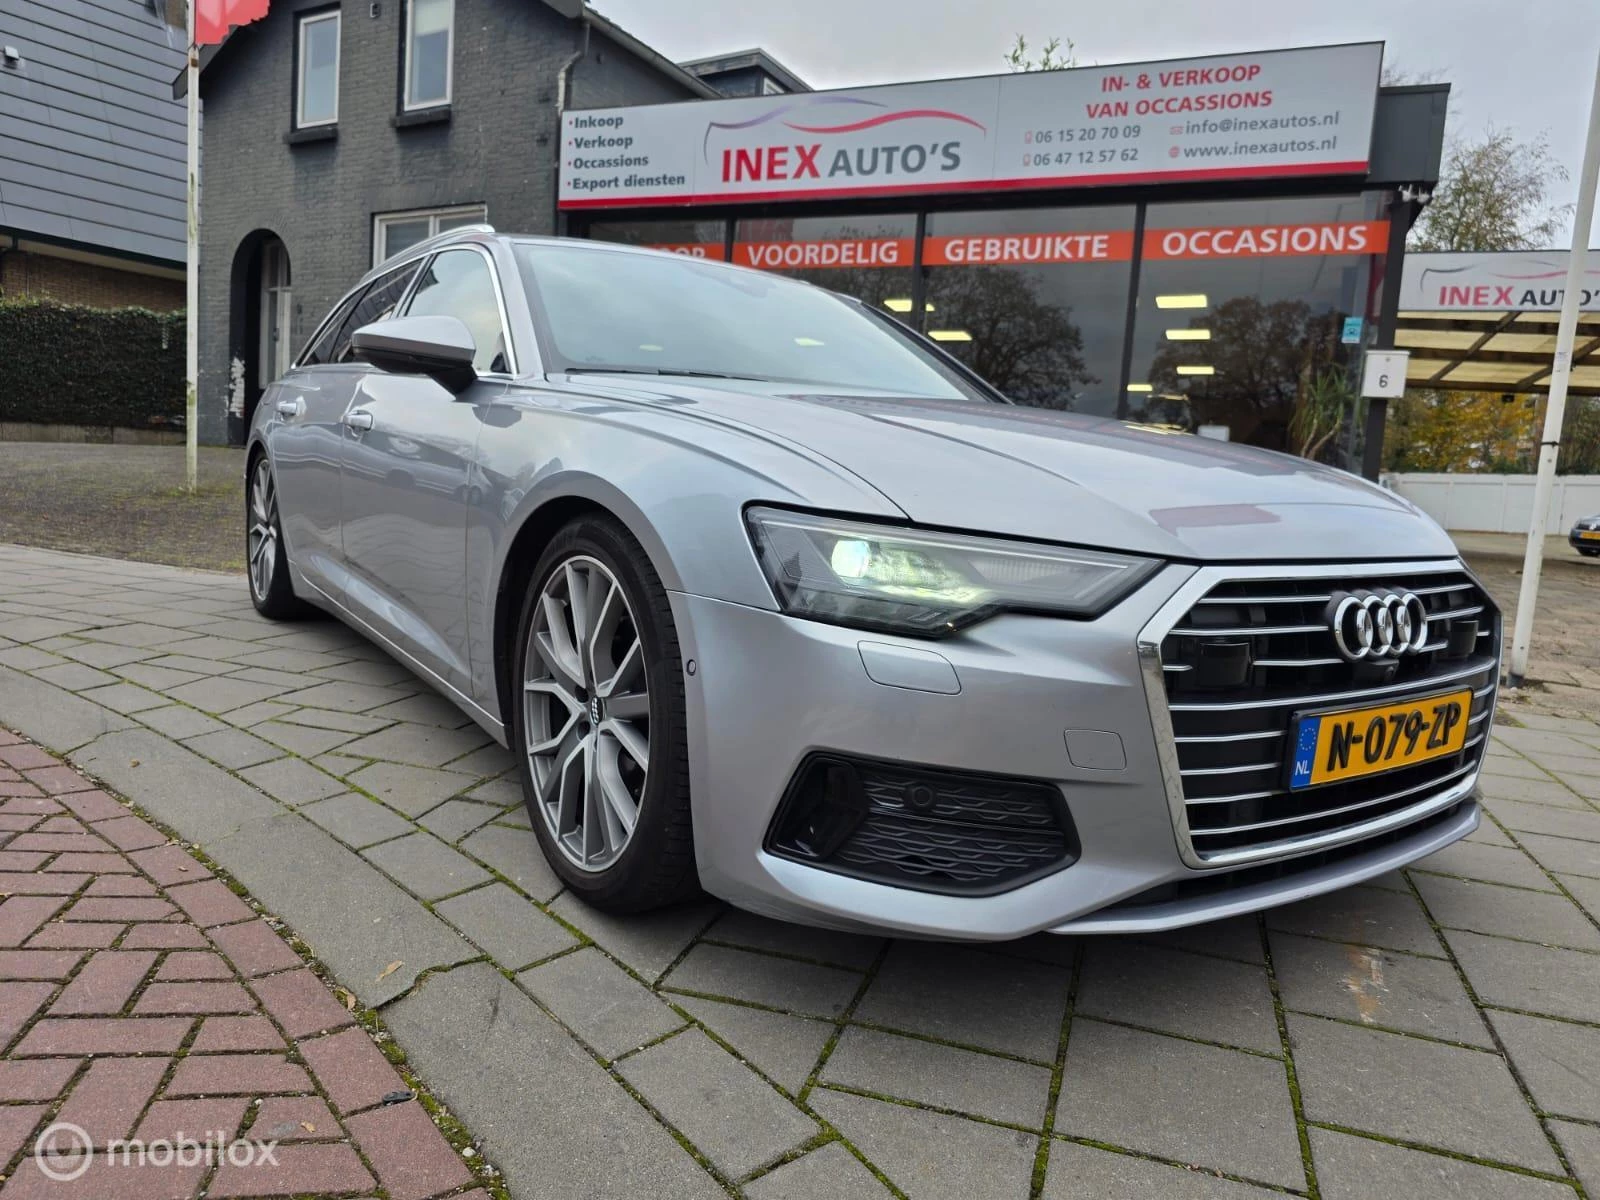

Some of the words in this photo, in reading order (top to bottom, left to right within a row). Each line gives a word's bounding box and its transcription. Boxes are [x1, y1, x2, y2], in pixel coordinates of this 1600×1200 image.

[1101, 75, 1130, 93] IN-
[1136, 73, 1151, 91] &
[1159, 64, 1262, 89] VERKOOP
[1086, 101, 1129, 119] VAN
[1135, 90, 1273, 116] OCCASSIONS
[574, 115, 624, 129] Inkoop
[1186, 110, 1340, 134] info@inexautos.nl
[574, 136, 633, 149] Verkoop
[1035, 130, 1052, 144] 06
[1058, 129, 1074, 142] 15
[1078, 128, 1096, 141] 20
[1101, 126, 1118, 139] 70
[1122, 125, 1141, 138] 09
[1183, 135, 1337, 158] www.inexautos.nl
[573, 155, 649, 169] Occassions
[721, 144, 821, 183] INEX
[827, 141, 962, 179] AUTO'S
[1033, 153, 1051, 166] 06
[1054, 152, 1072, 165] 47
[1078, 151, 1093, 164] 12
[1098, 149, 1116, 163] 57
[1120, 148, 1138, 161] 62
[572, 177, 620, 192] Export
[624, 173, 685, 188] diensten
[747, 241, 899, 267] VOORDELIG
[944, 235, 1109, 262] GEBRUIKTE
[1162, 225, 1367, 256] OCCASIONS
[1438, 285, 1515, 307] INEX
[1378, 374, 1389, 389] 6
[1326, 701, 1462, 772] N-079-ZP
[1294, 760, 1310, 776] NL
